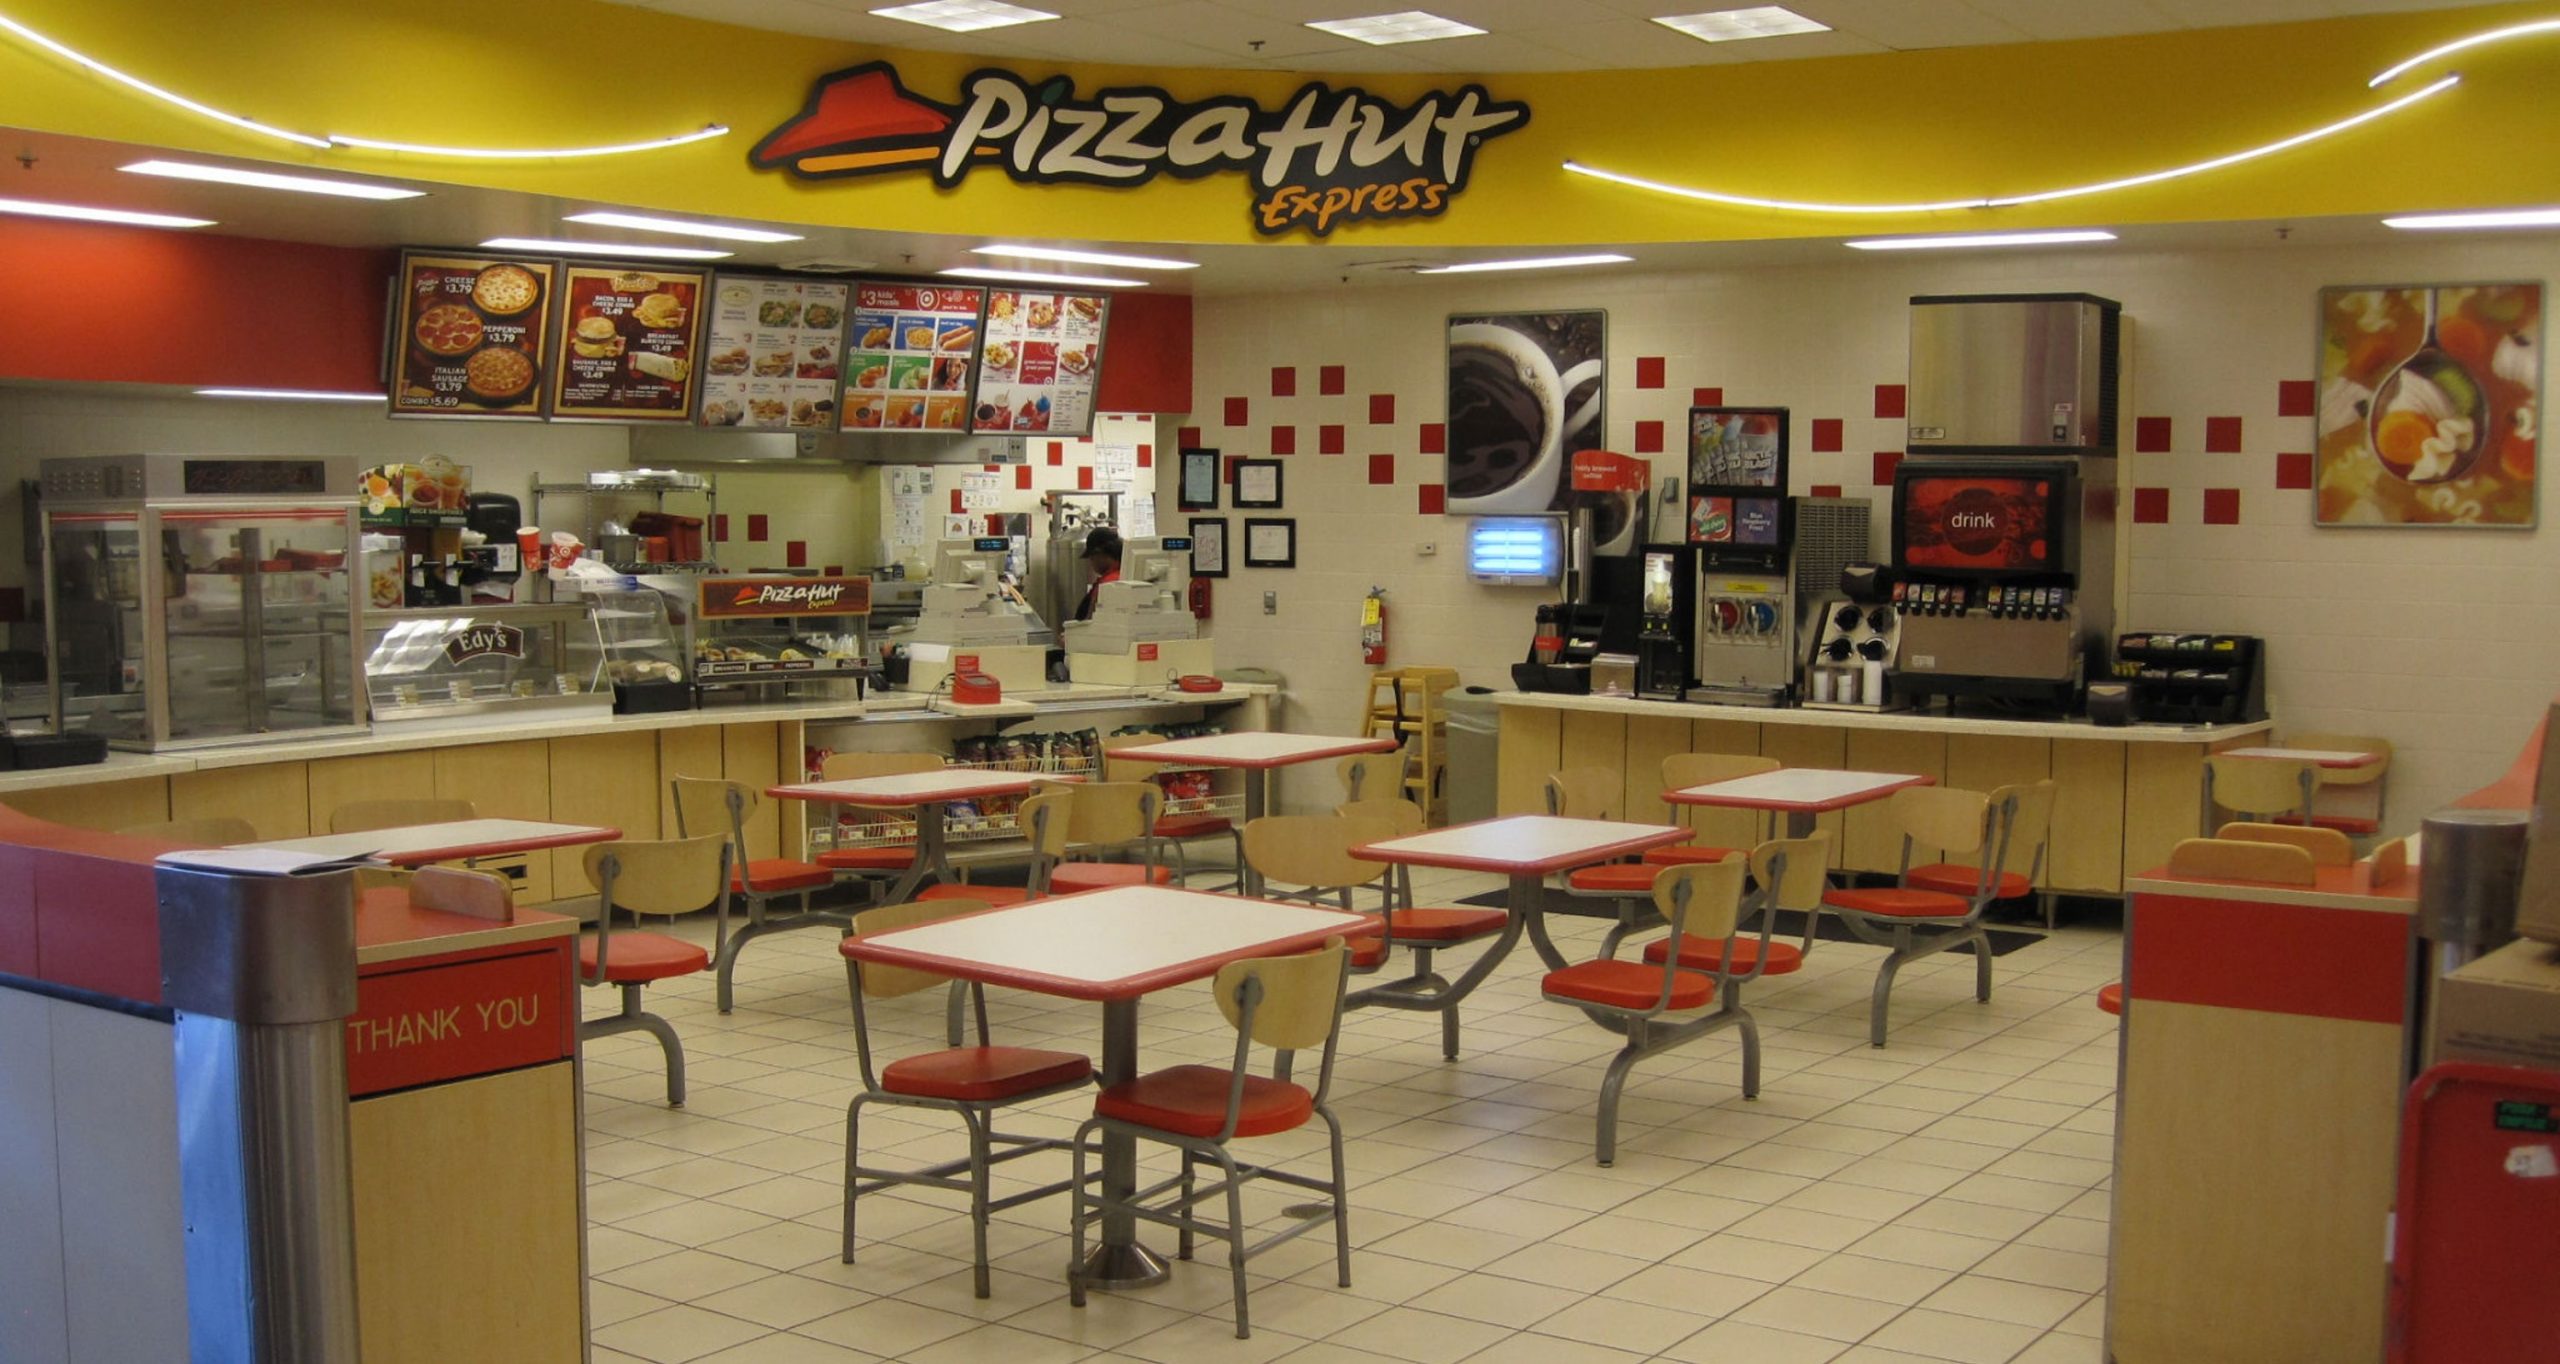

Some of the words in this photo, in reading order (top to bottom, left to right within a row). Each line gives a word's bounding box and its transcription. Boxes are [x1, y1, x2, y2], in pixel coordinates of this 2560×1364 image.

[942, 76, 1257, 179] Pizza
[1256, 89, 1519, 186] Hut
[1259, 178, 1448, 232] Express
[444, 276, 475, 285] CHEESE
[445, 284, 472, 294] $3.79
[483, 326, 526, 334] PEPPERONI
[490, 333, 515, 343] $3.79
[435, 367, 467, 375] ITALIAN
[432, 375, 468, 383] SAUSAGE
[436, 382, 462, 392] $3.79
[1951, 512, 1996, 528] drink
[759, 584, 807, 604] Pizza
[806, 583, 846, 601] Hut
[459, 630, 507, 652] Edy's
[349, 1004, 462, 1055] THANK
[475, 993, 540, 1031] YOU
